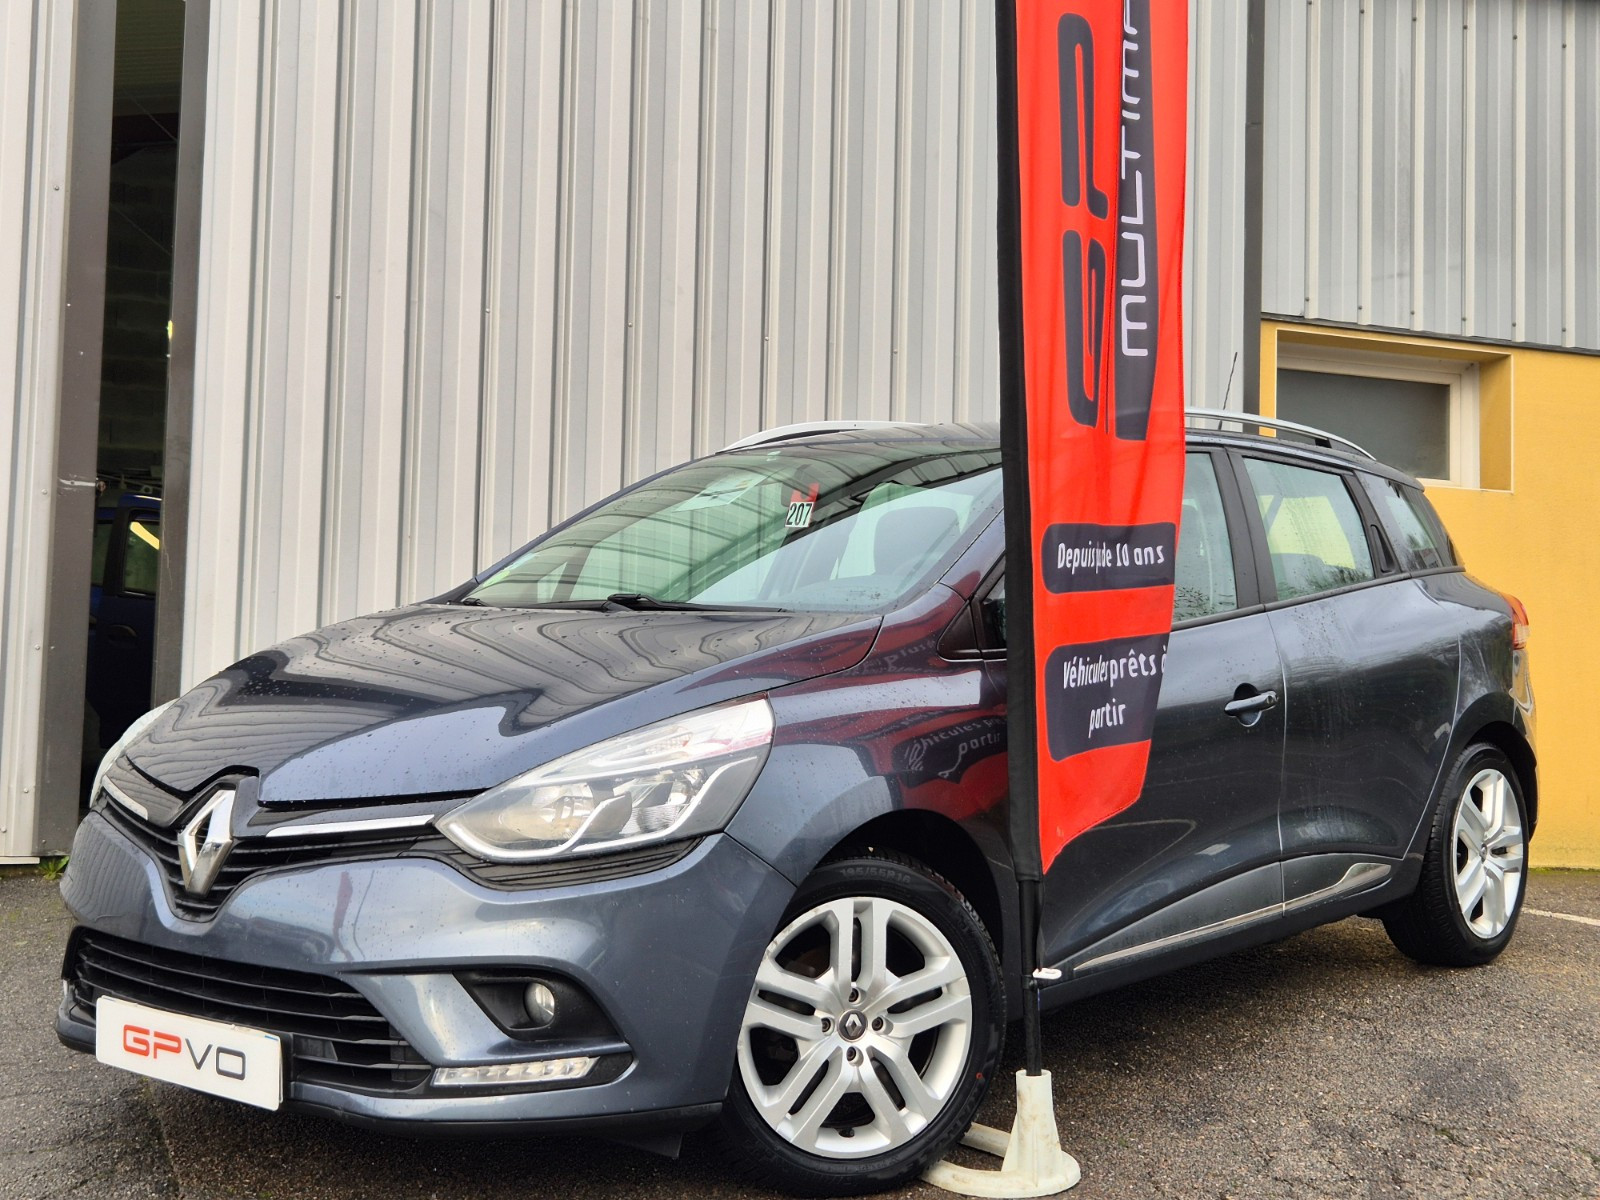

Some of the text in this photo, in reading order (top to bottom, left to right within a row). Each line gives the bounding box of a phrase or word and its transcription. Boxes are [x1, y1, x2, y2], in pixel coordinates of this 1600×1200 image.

[786, 502, 813, 526] 207
[1116, 543, 1129, 566] 10
[1133, 545, 1165, 566] ans
[1109, 648, 1156, 688] prêts
[1088, 698, 1126, 739] partir
